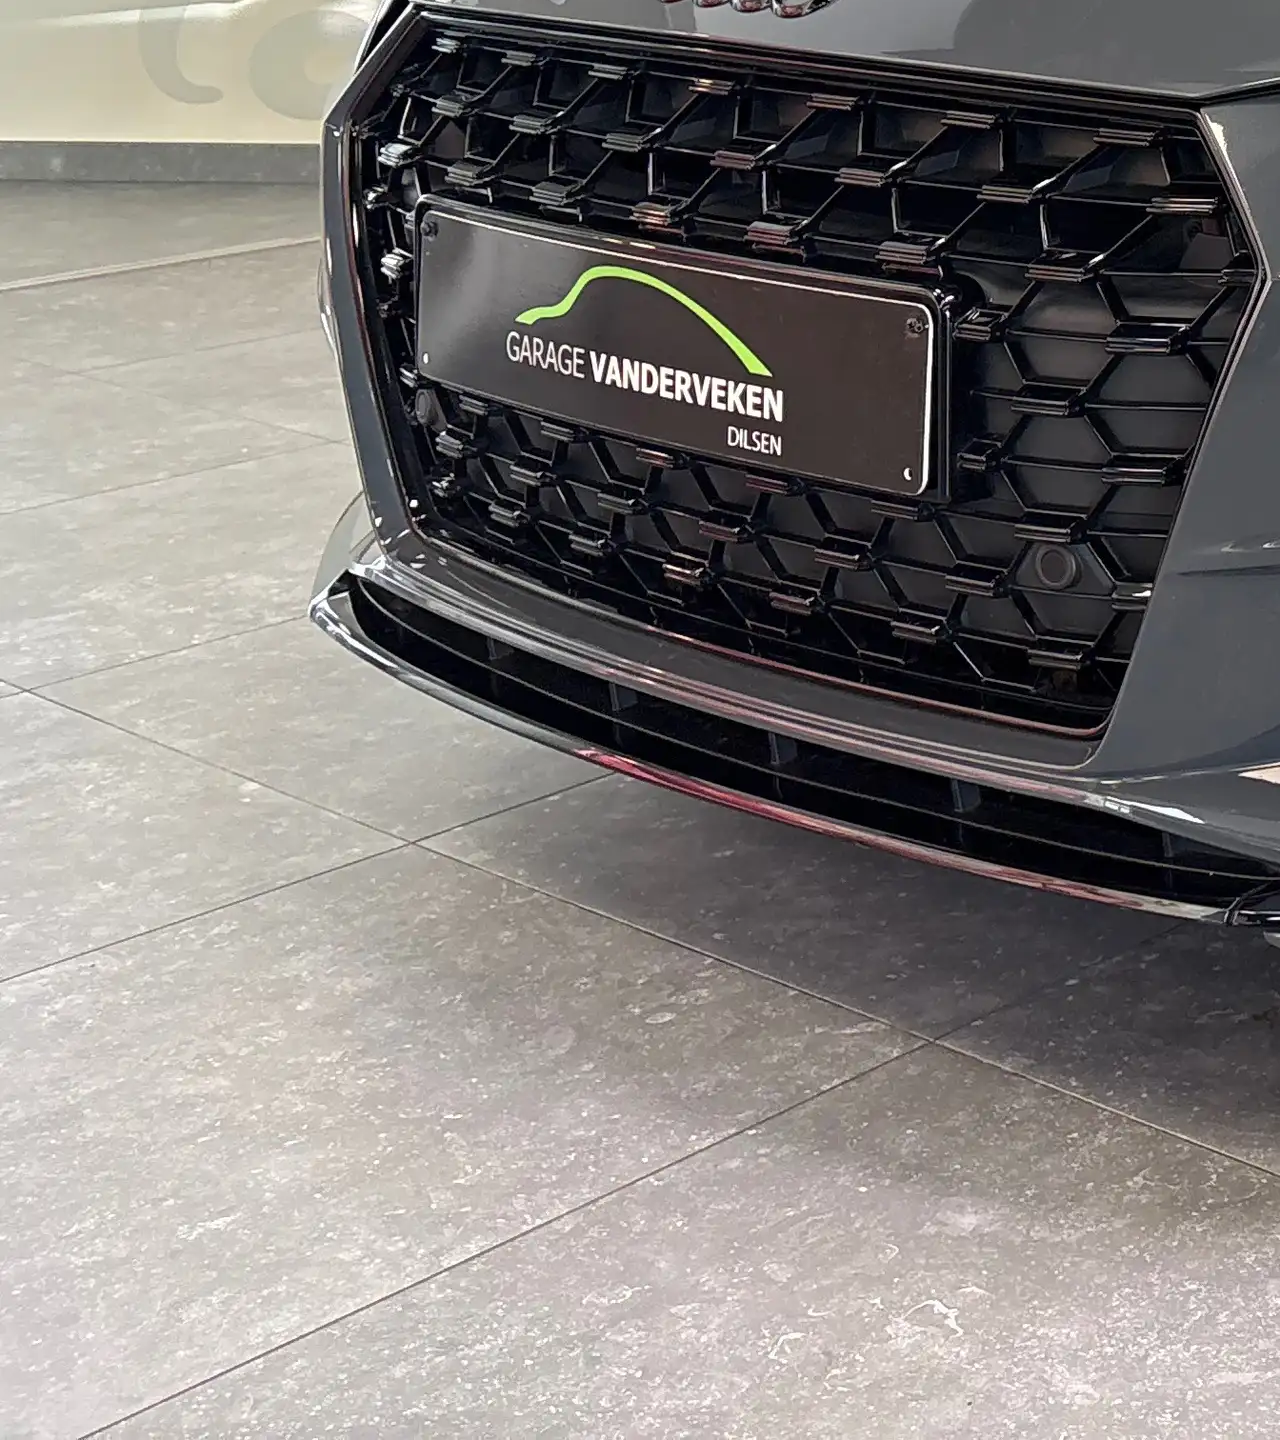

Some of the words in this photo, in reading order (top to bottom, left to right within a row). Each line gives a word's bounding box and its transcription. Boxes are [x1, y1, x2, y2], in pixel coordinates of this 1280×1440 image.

[506, 331, 585, 379] GARAGE
[589, 351, 784, 423] VANDERVEKEN
[727, 426, 782, 456] DILSEN
